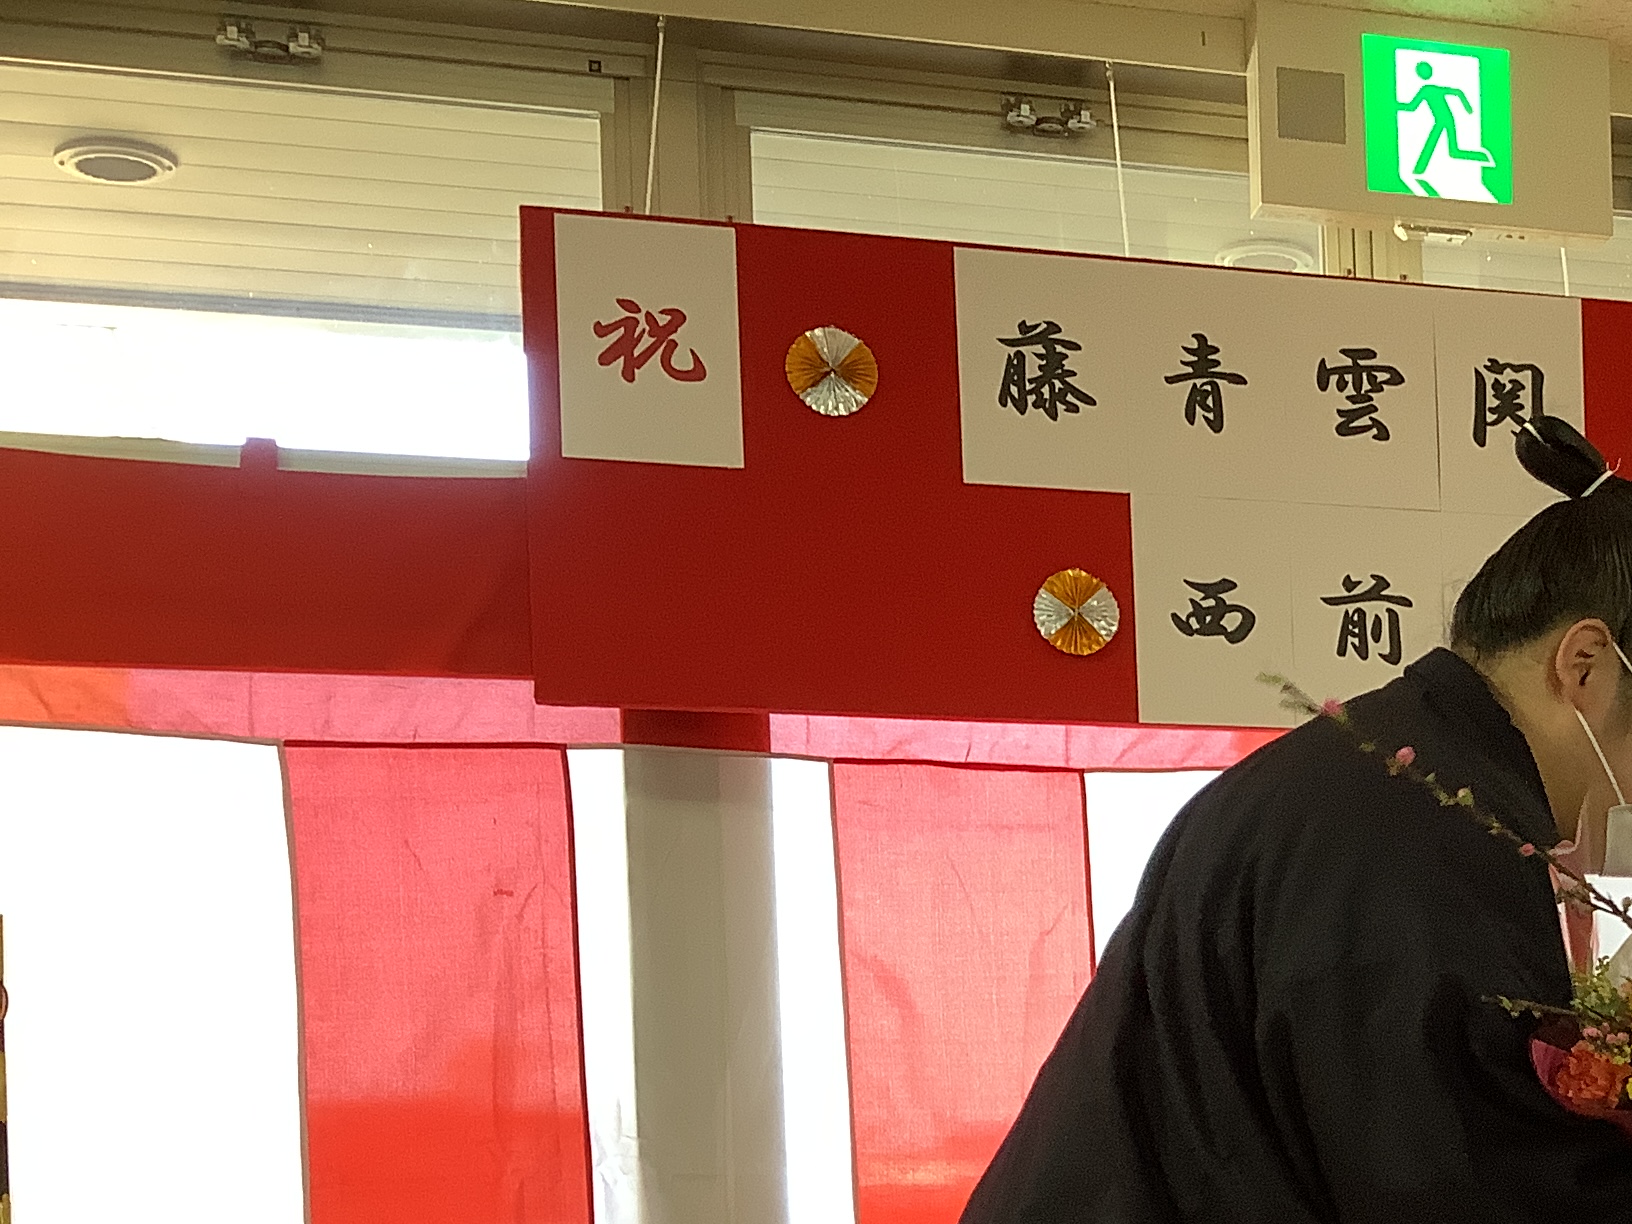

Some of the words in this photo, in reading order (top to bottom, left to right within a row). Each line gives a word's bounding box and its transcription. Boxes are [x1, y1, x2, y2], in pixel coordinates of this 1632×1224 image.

[594, 298, 707, 383] 祝
[995, 319, 1545, 448] 藤青雲関
